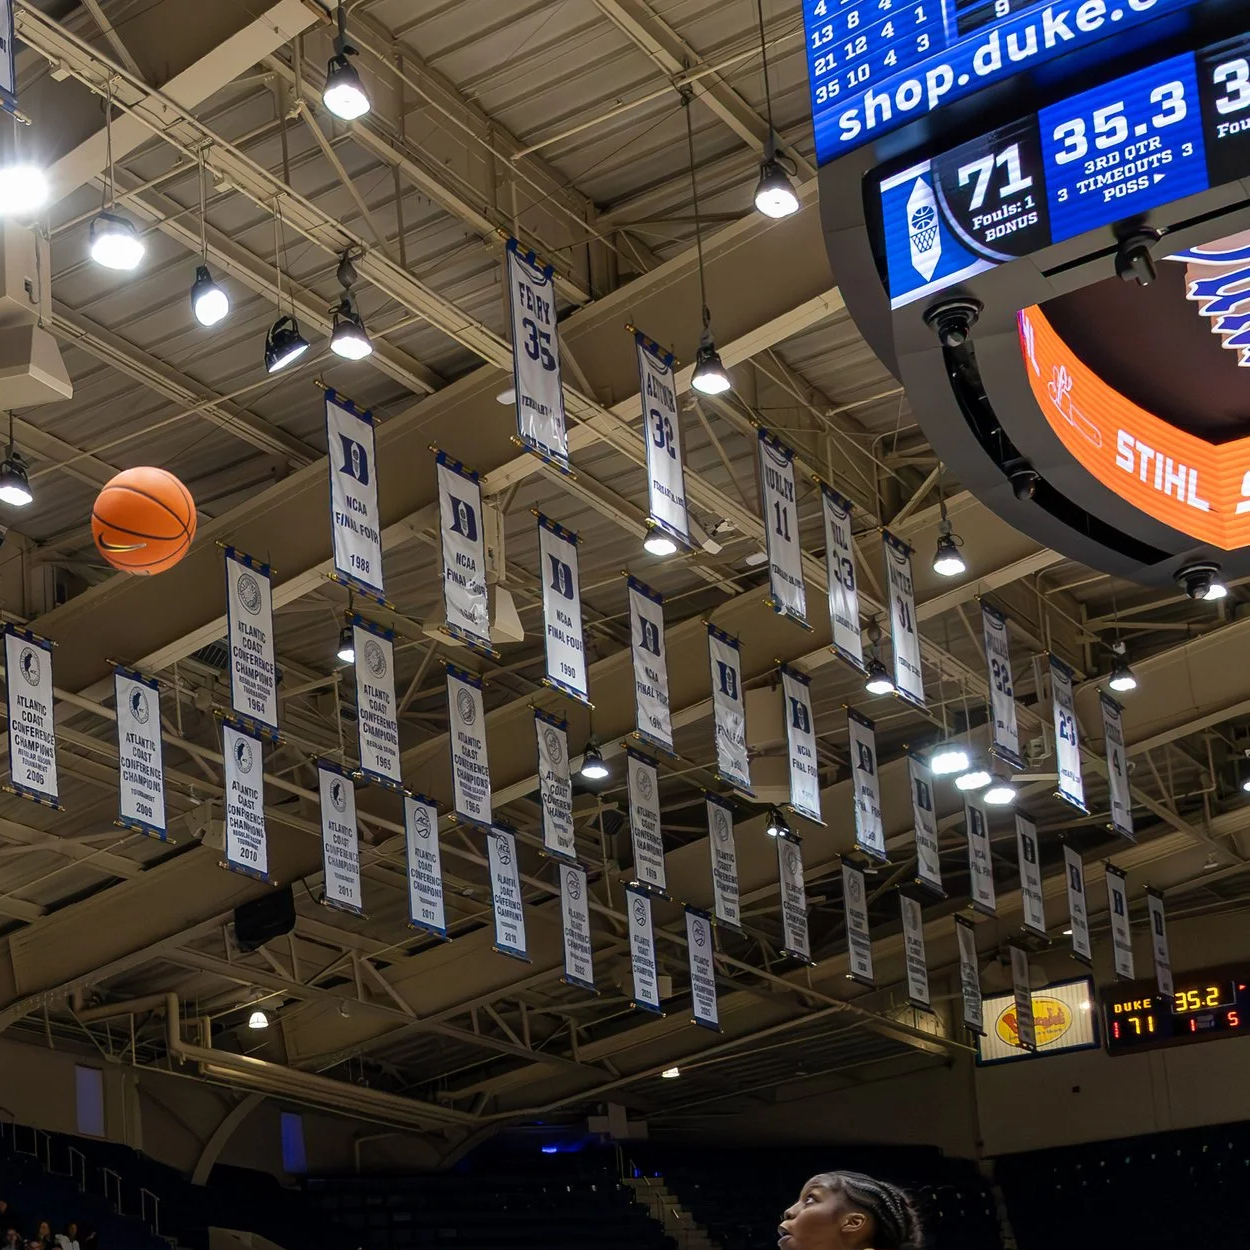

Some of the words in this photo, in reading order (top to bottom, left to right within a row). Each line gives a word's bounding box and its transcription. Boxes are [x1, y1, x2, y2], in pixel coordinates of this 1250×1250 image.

[811, 24, 834, 49] 13
[847, 10, 860, 29] 8
[814, 53, 837, 77] 21
[844, 35, 868, 60] 12
[880, 21, 895, 39] 4
[914, 6, 928, 24] 1
[815, 78, 840, 104] 35
[846, 63, 870, 88] 10
[883, 49, 898, 67] 4
[916, 33, 930, 53] 3
[1053, 80, 1188, 165] 35.3
[1084, 151, 1120, 174] 3RD
[1124, 136, 1162, 162] QTR
[958, 142, 1034, 212] 71
[1057, 188, 1069, 202] 3
[1076, 149, 1173, 195] TIMEOUTS
[1181, 142, 1194, 157] 3
[1103, 175, 1150, 203] POSS
[972, 200, 1023, 231] Fouls:
[984, 211, 1039, 242] BONUS
[522, 317, 556, 371] 35
[1115, 428, 1211, 513] STIHL
[346, 495, 368, 516] NCAA
[335, 512, 359, 534] FINAL
[350, 554, 370, 574] 1988
[456, 552, 476, 571] NCAA
[556, 609, 572, 628] NCAA
[548, 624, 565, 643] FINAL
[233, 646, 274, 674] CONFERENCE
[560, 662, 576, 679] 1990
[235, 661, 273, 689] CHAMPIONS
[16, 695, 47, 715] ATLANTIC
[364, 684, 390, 704] ATLANTIC
[247, 697, 265, 715] 1964
[369, 699, 387, 716] COAST
[21, 710, 44, 727] COAST
[360, 709, 397, 733] CONFERENCE
[12, 720, 55, 746] CONFERENCE
[126, 732, 156, 752] ATLANTIC
[363, 722, 398, 745] CHAMPIONS
[14, 735, 55, 759] CHAMPIONS
[132, 747, 152, 763] COAST
[121, 757, 162, 781] CONFERENCE
[375, 754, 392, 771] 1965
[26, 769, 45, 785] 2006
[123, 771, 161, 793] CHAMPIONS
[456, 769, 488, 789] CHAMPIONS
[136, 802, 152, 818] 2009
[465, 799, 481, 814] 1966
[240, 846, 258, 862] 2010
[1114, 998, 1152, 1014] DUKE
[1174, 987, 1219, 1013] 35.2
[1128, 1016, 1154, 1035] 71
